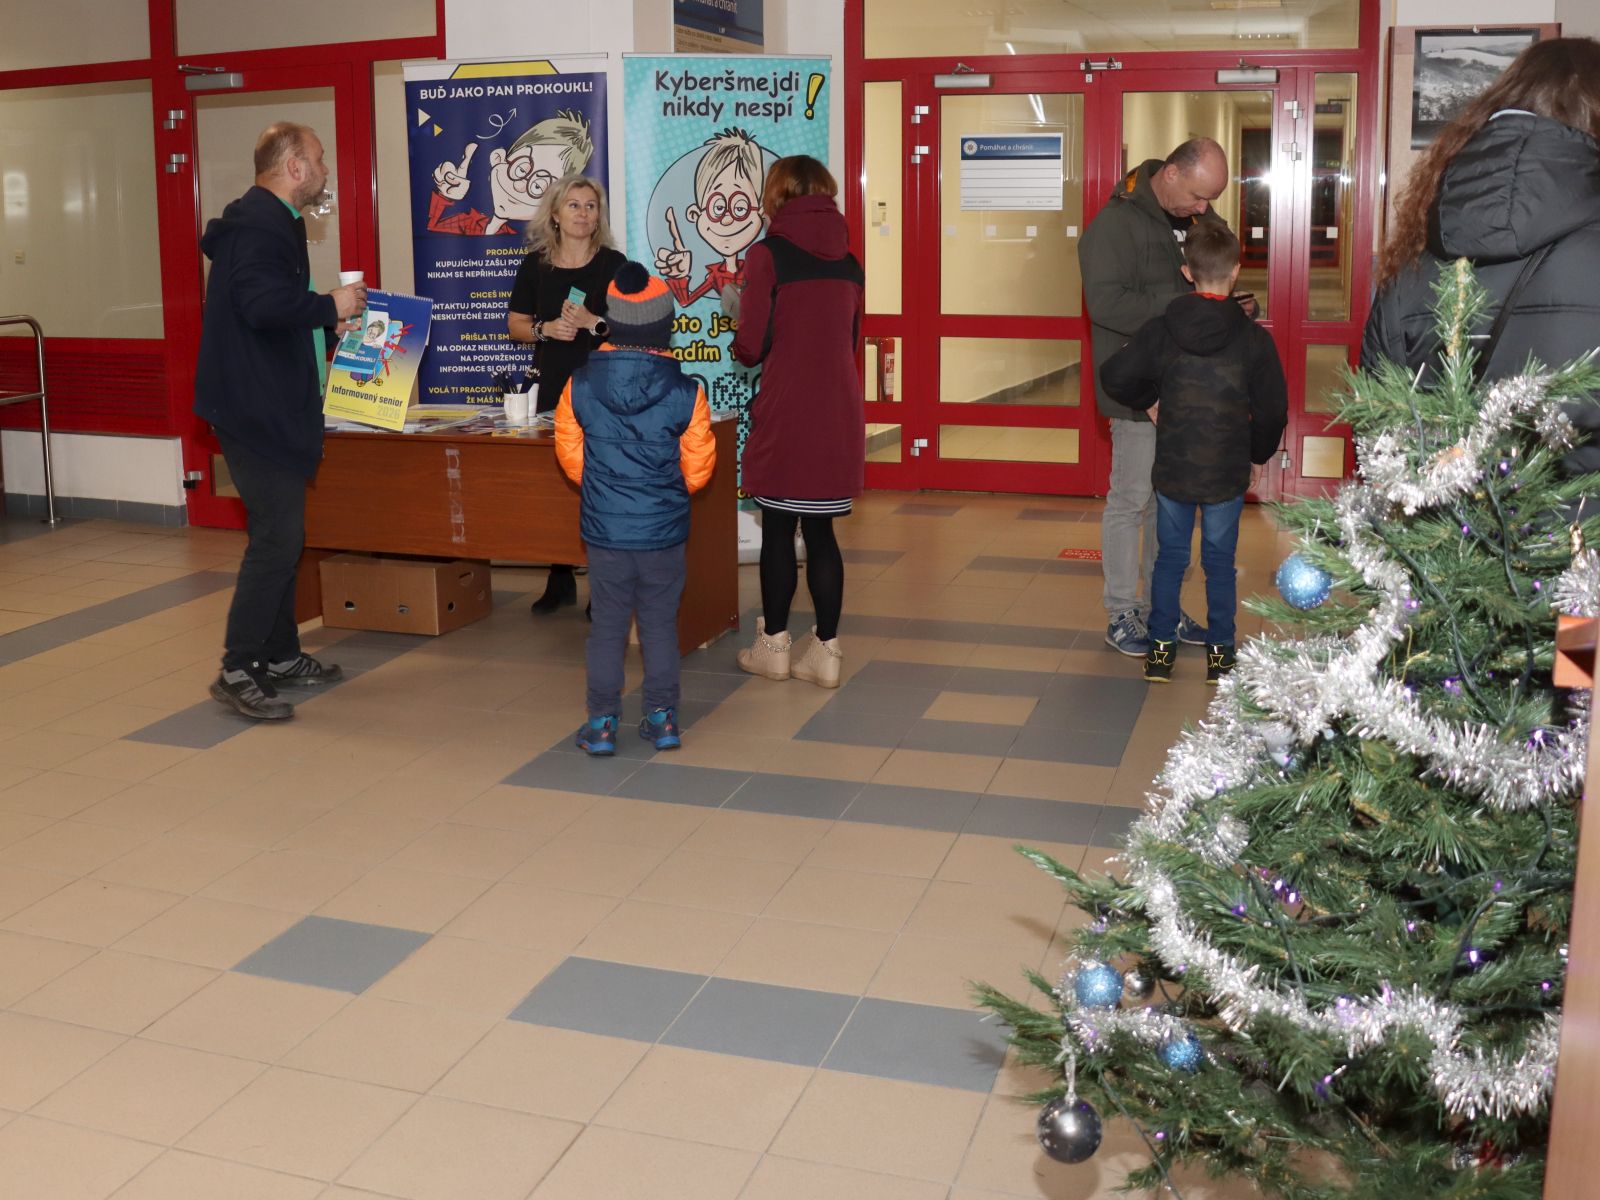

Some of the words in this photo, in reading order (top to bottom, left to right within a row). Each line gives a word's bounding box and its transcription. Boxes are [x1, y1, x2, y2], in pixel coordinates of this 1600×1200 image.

[655, 69, 800, 98] Kyberšmejdi
[420, 85, 447, 100] BUĎ
[450, 86, 484, 98] JAKO
[487, 84, 514, 97] PAN
[517, 82, 593, 95] PROKOUKL!
[663, 96, 725, 123] nikdy
[735, 95, 794, 123] nespí
[435, 258, 484, 268] KUPUJÍCÍMU
[484, 258, 507, 268] ZAŠLI
[427, 271, 453, 279] NIKAM
[465, 269, 517, 278] NEPŘIHLAŠUJ
[470, 290, 498, 299] CHCEŠ
[431, 311, 482, 321] NESKUTEČNÉ
[483, 312, 506, 320] ZISKY
[460, 333, 488, 341] PŘIŠLA
[478, 343, 516, 352] NEKLIKEJ,
[473, 353, 526, 362] PODVRŽENOU
[440, 365, 486, 373] INFORMACE
[496, 363, 517, 372] OVĚŘ
[429, 386, 449, 394] VOLÁ
[331, 384, 379, 404] Informovaný
[379, 395, 404, 408] senior
[466, 395, 476, 404] ŽE
[477, 394, 494, 403] MÁŠ
